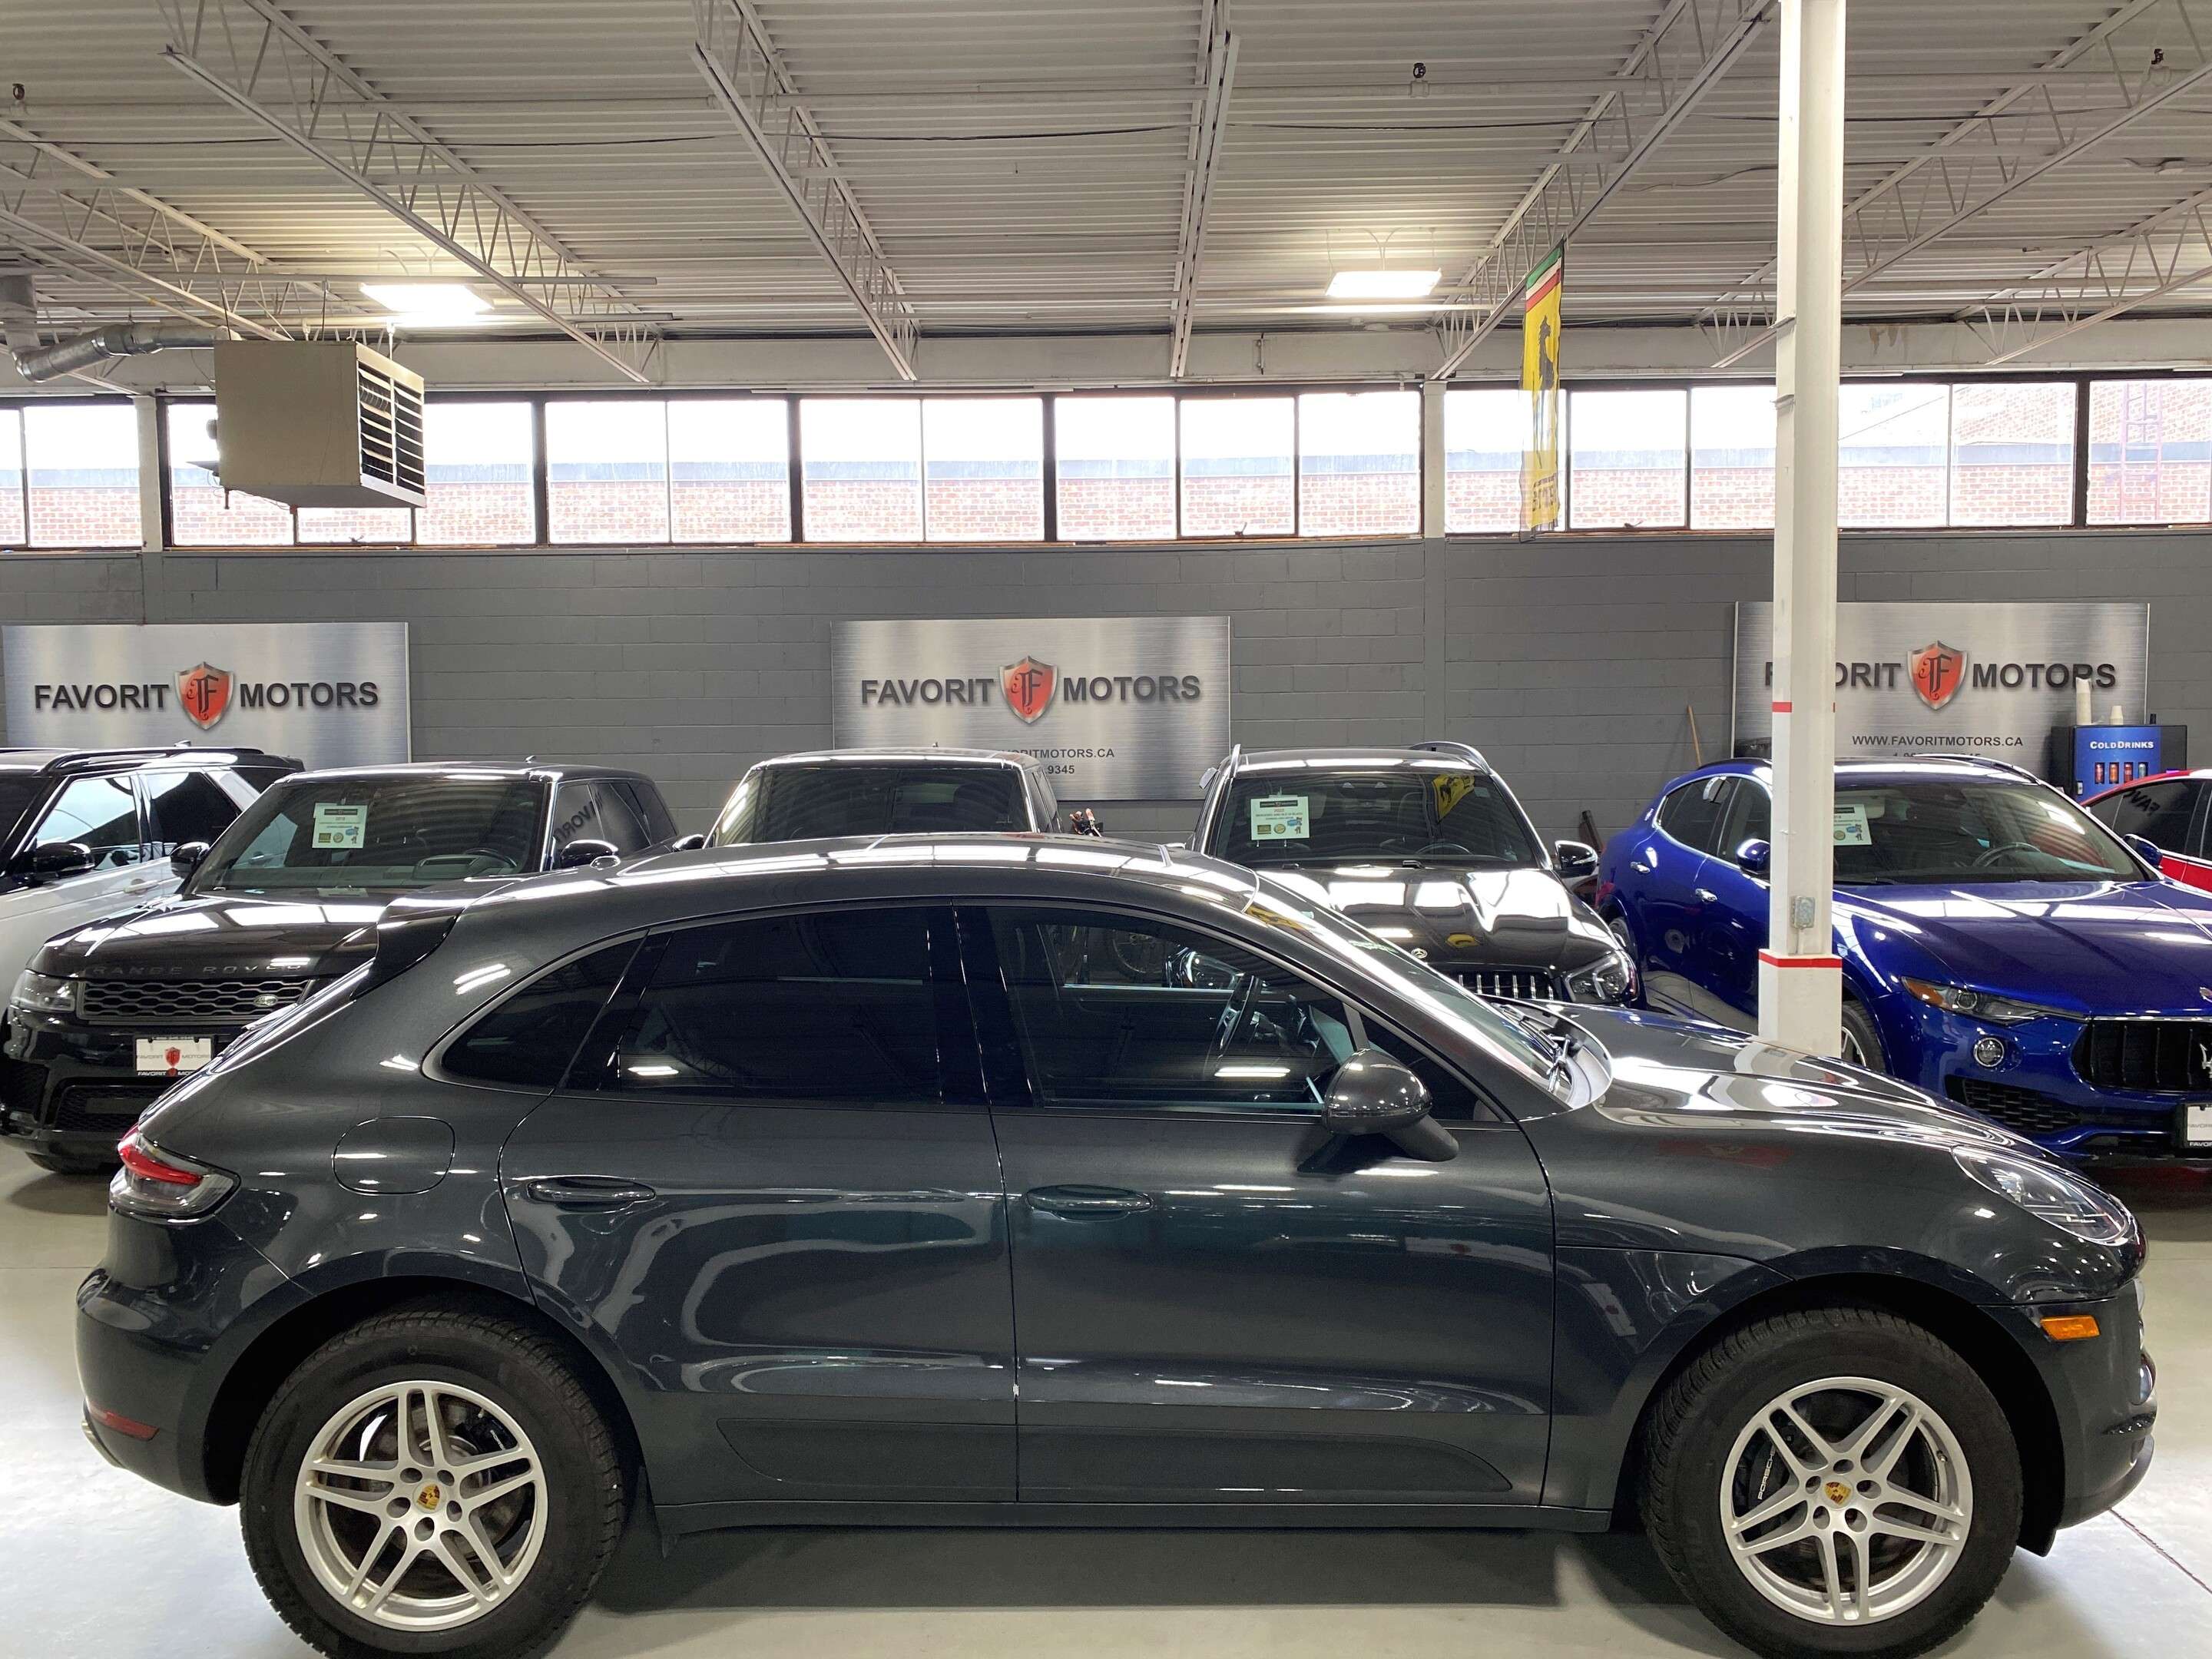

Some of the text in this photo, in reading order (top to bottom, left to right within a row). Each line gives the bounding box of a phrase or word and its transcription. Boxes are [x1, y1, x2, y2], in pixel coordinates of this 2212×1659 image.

[861, 678, 994, 704] FAVORIT
[1063, 675, 1200, 702] MOTORS
[1972, 662, 2116, 689] MOTORS
[34, 684, 169, 710] FAVORIT
[240, 681, 379, 709] MOTORS
[1852, 735, 2024, 747] WWW.FAVORITMOTORS.CA
